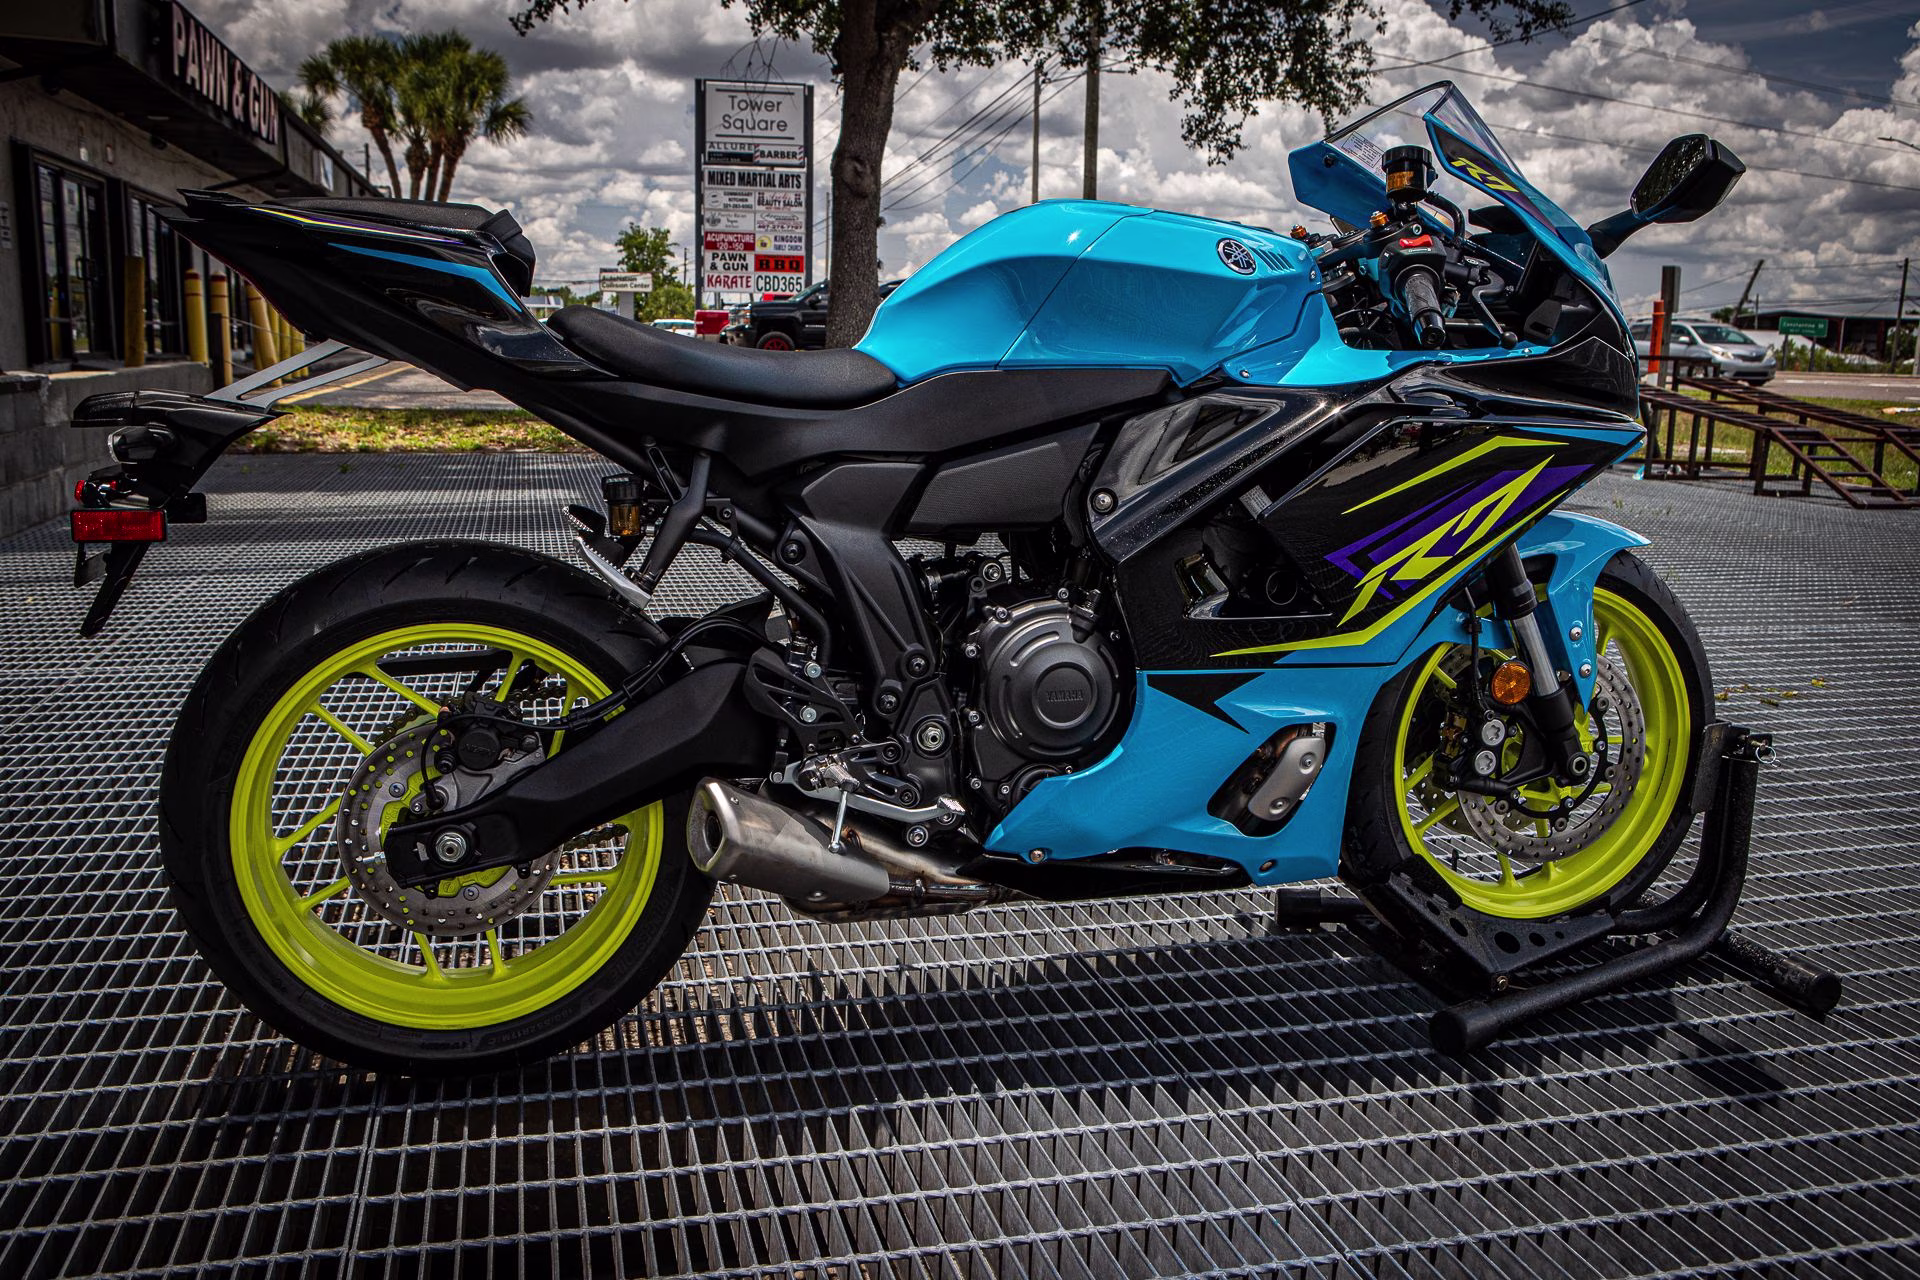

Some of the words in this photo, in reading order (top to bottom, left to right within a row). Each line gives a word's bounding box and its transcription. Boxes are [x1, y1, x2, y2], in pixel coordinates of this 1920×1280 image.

[172, 1, 229, 111] PAWN
[232, 60, 244, 122] &
[250, 74, 279, 145] GUN
[728, 95, 783, 112] Tower
[722, 114, 788, 133] Square
[760, 150, 798, 159] BARBER
[707, 171, 736, 186] MIXED
[738, 172, 777, 188] MARTIAL
[778, 173, 801, 189] ARTS
[706, 233, 754, 242] ACUPUNCTURE
[774, 235, 803, 243] KINGDOM
[712, 252, 747, 262] PAWN
[709, 262, 718, 271] &
[722, 262, 749, 271] GUN
[707, 274, 752, 289] KARATE
[756, 275, 803, 292] CBD365
[1046, 689, 1083, 702] YAMAHA
